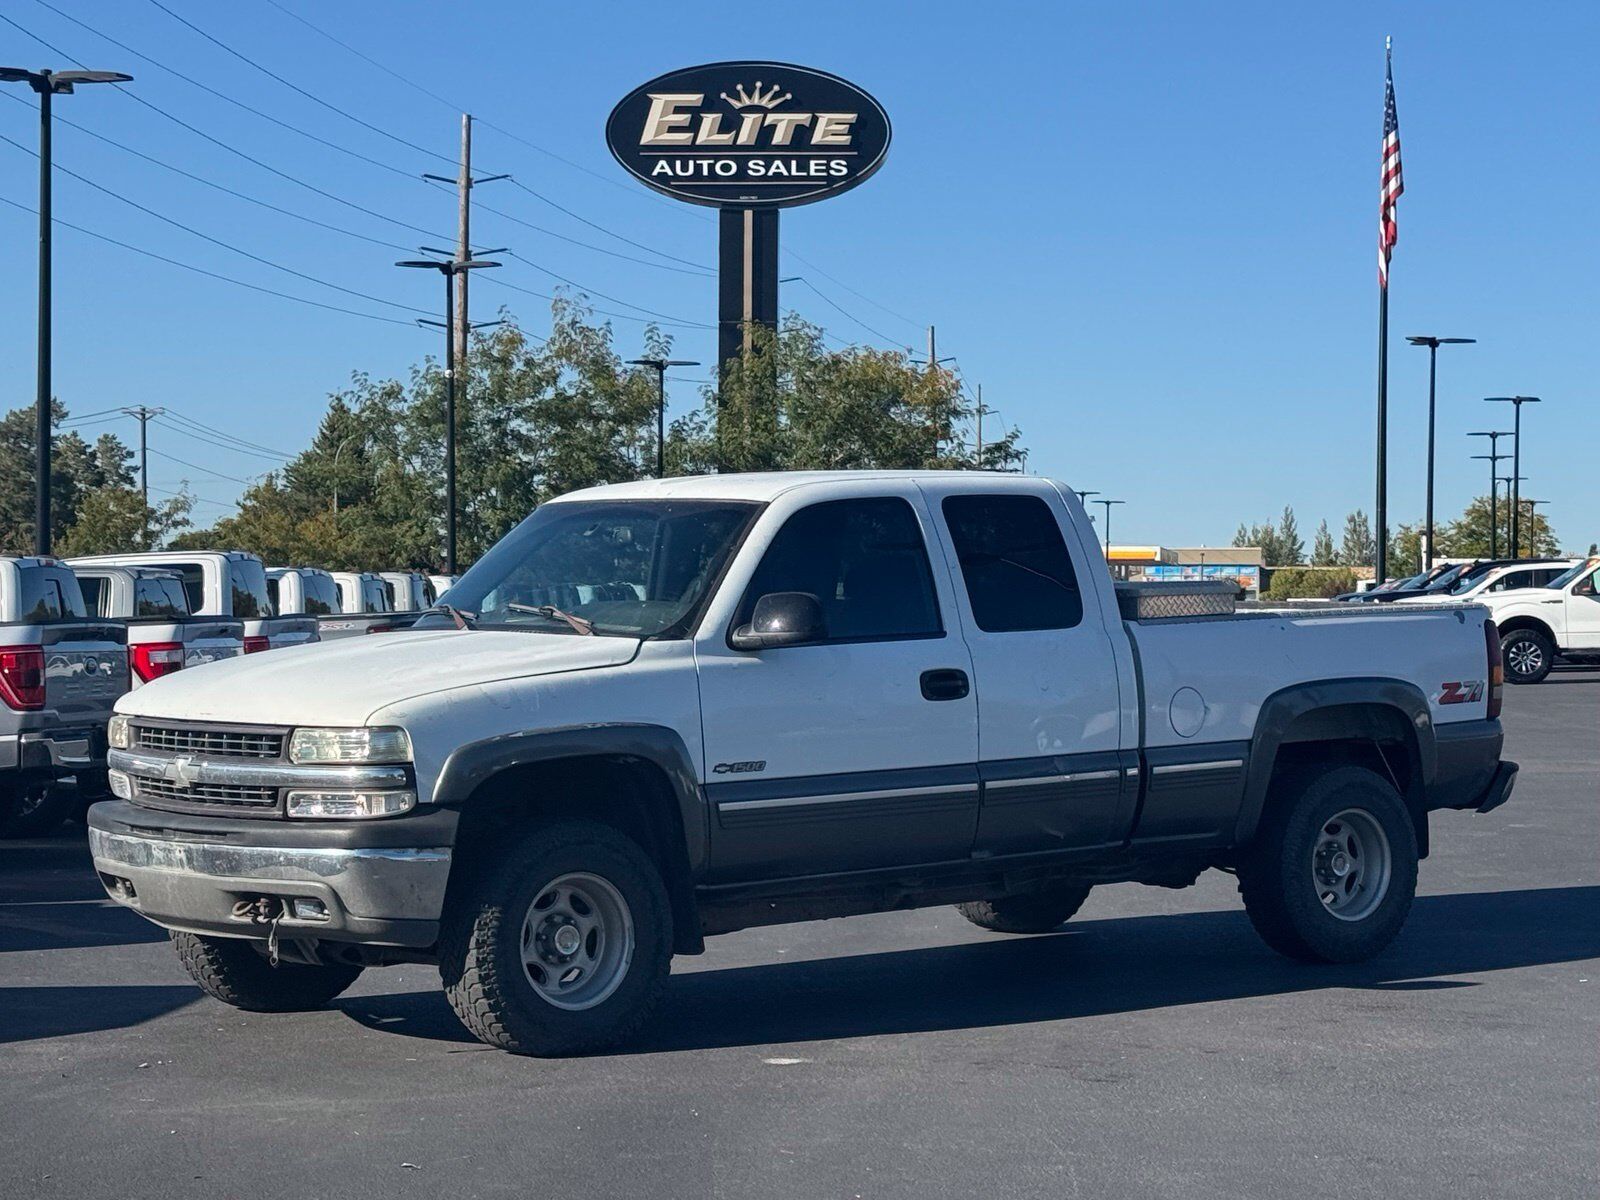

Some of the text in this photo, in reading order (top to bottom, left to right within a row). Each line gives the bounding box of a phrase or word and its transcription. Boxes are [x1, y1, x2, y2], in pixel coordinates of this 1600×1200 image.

[639, 93, 858, 145] ELITE
[651, 159, 848, 176] AUTO SALES
[1438, 681, 1484, 705] Z71
[731, 760, 766, 773] 1500
